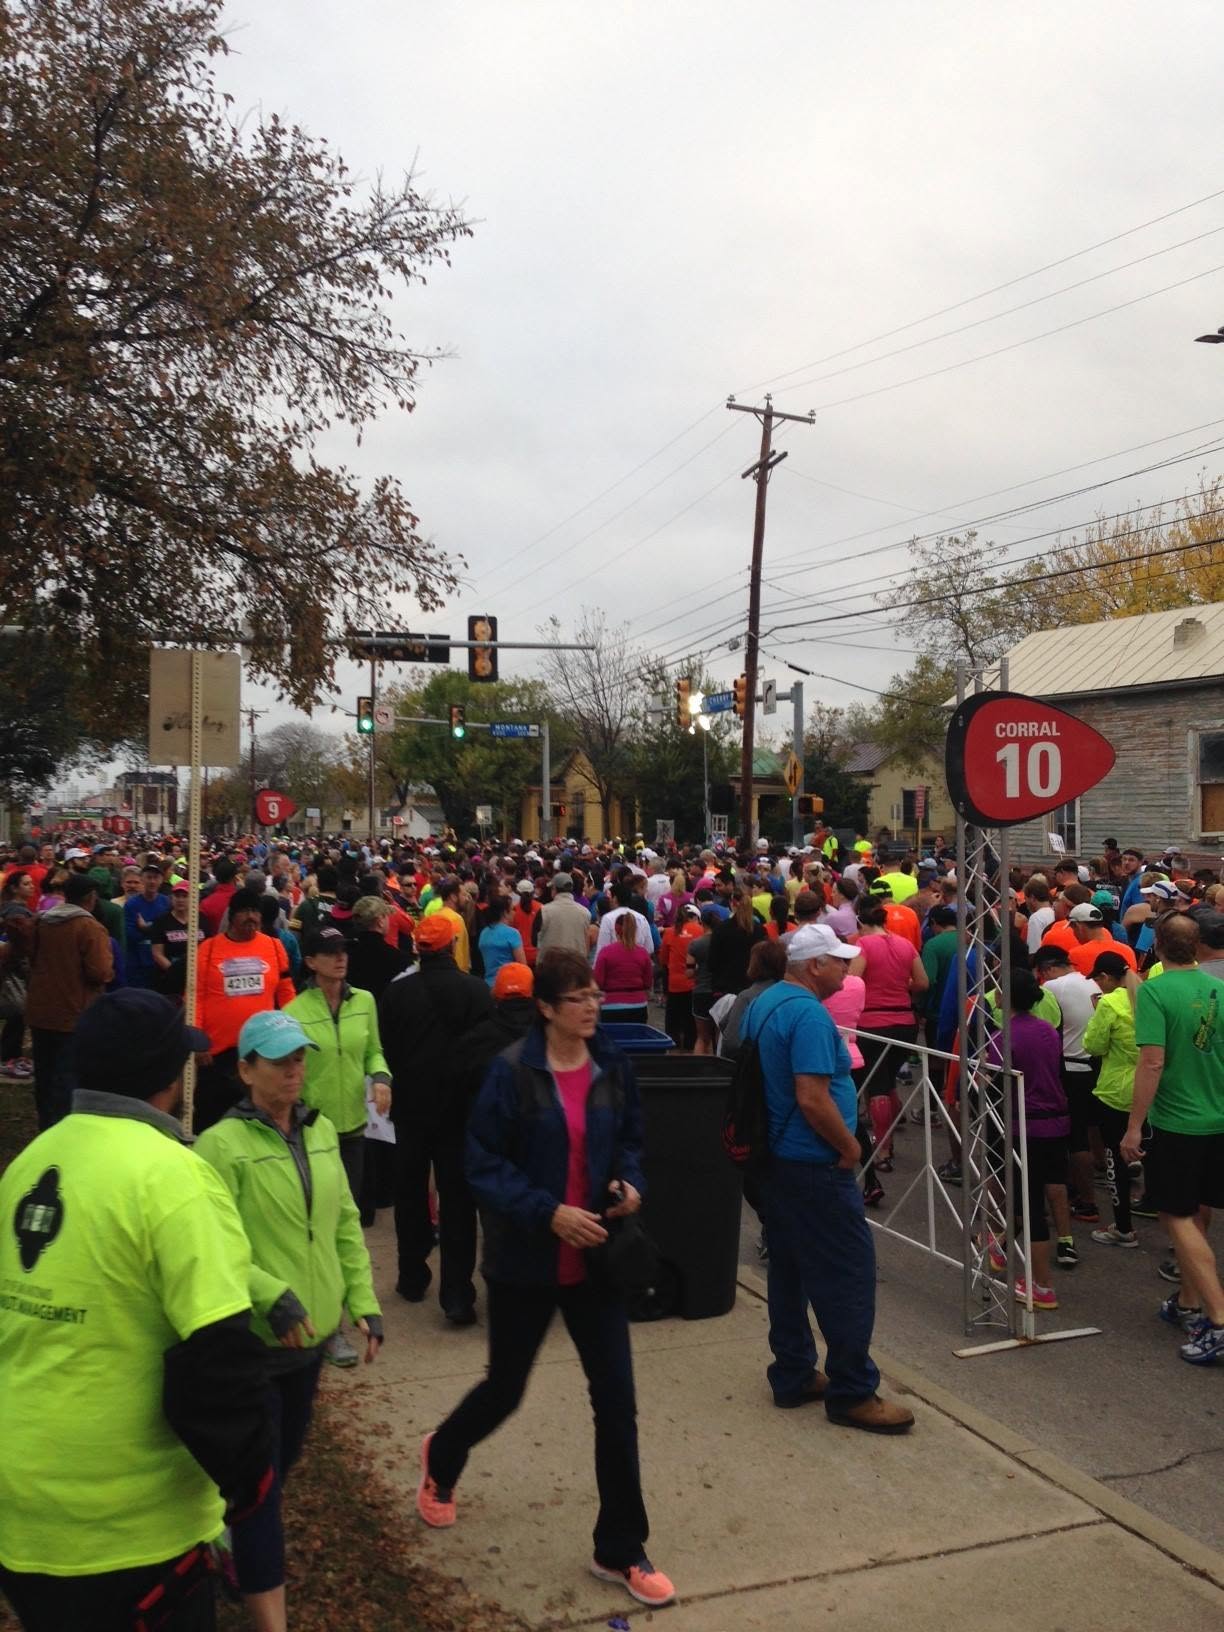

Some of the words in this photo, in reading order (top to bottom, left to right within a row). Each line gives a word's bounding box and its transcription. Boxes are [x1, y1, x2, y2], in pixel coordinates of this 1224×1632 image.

[995, 721, 1061, 738] CORRAL
[996, 741, 1062, 798] 10
[268, 801, 280, 819] 9
[227, 976, 261, 989] 42104
[1104, 1147, 1120, 1207] adidas
